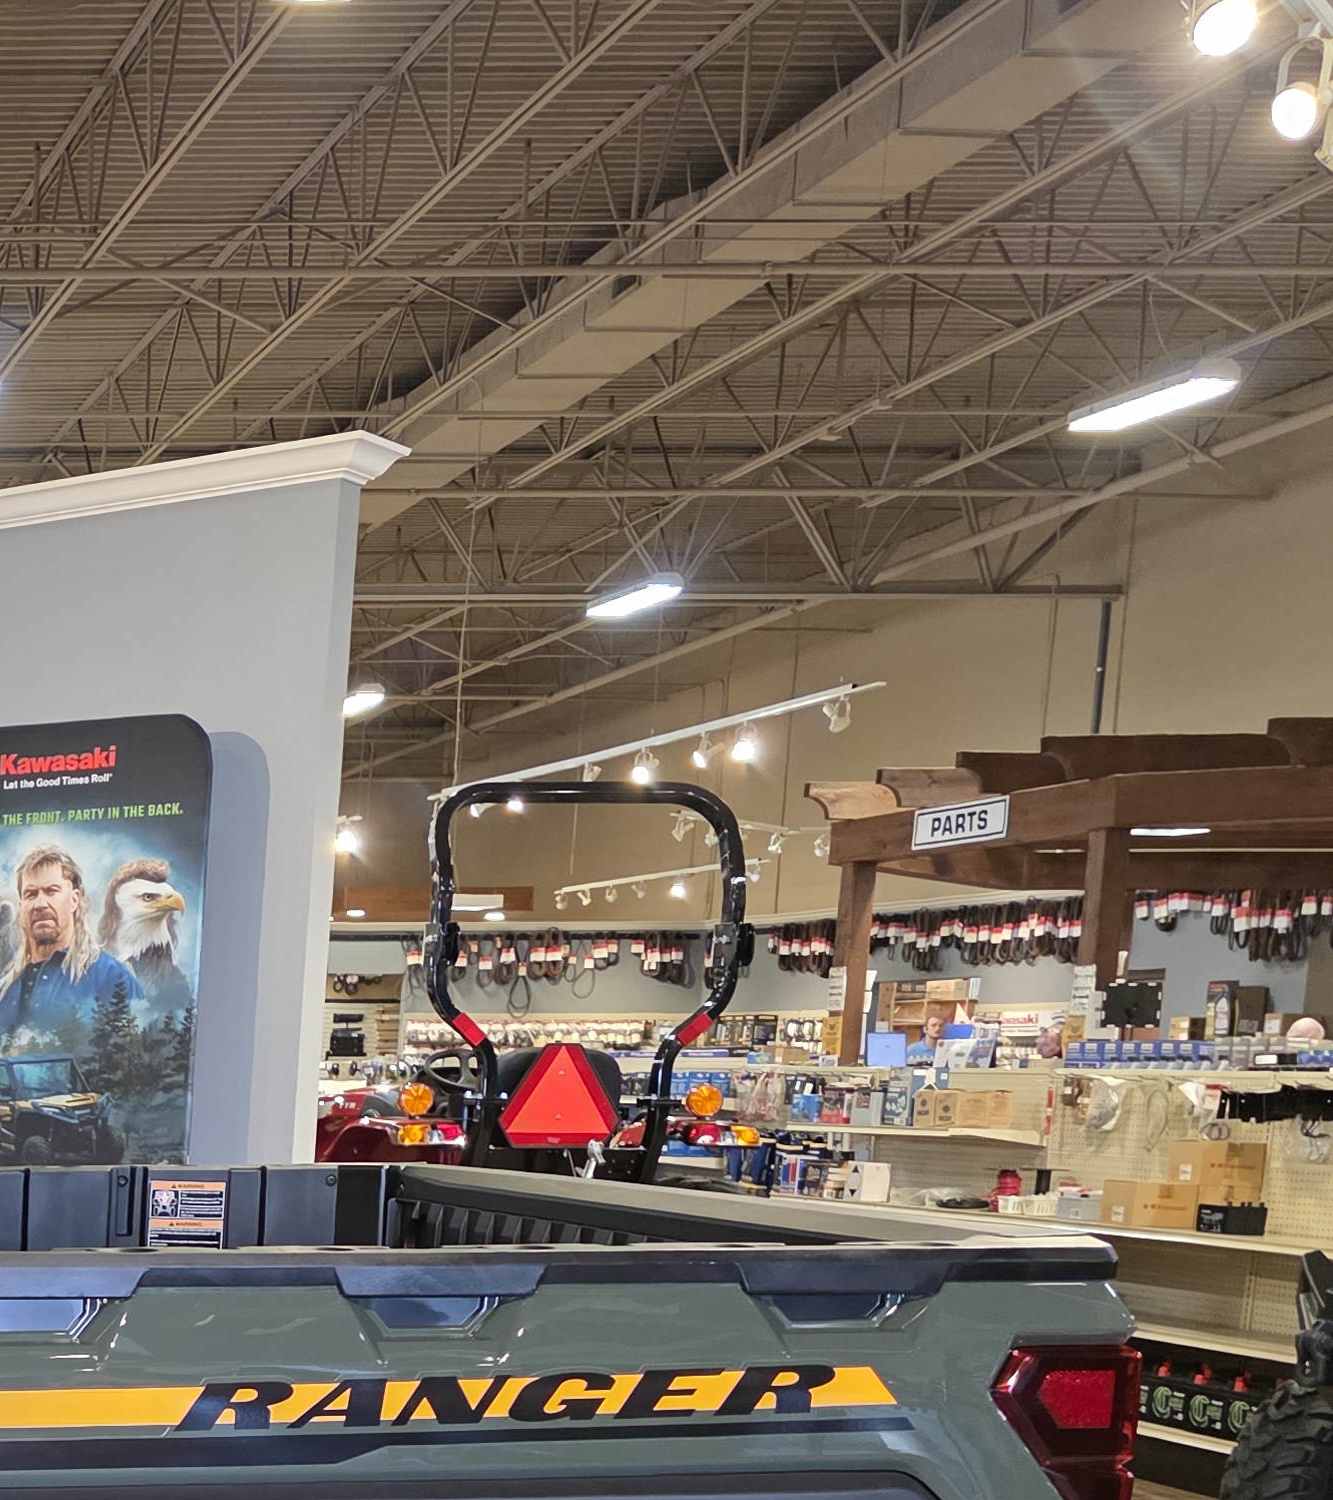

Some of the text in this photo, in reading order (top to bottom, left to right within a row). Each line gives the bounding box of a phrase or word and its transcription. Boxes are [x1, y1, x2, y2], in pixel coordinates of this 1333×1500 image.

[0, 745, 116, 775] Kawasaki
[3, 780, 18, 790] Let
[20, 778, 35, 788] the
[36, 777, 61, 787] Good
[62, 775, 90, 786] Times
[2, 813, 23, 826] THE
[26, 810, 65, 824] FRONT.
[67, 807, 105, 822] PARTY
[107, 806, 120, 819] IN
[122, 804, 145, 818] THE
[148, 802, 183, 817] BACK.
[930, 809, 988, 838] PARTS
[173, 1364, 836, 1431] RANGER
